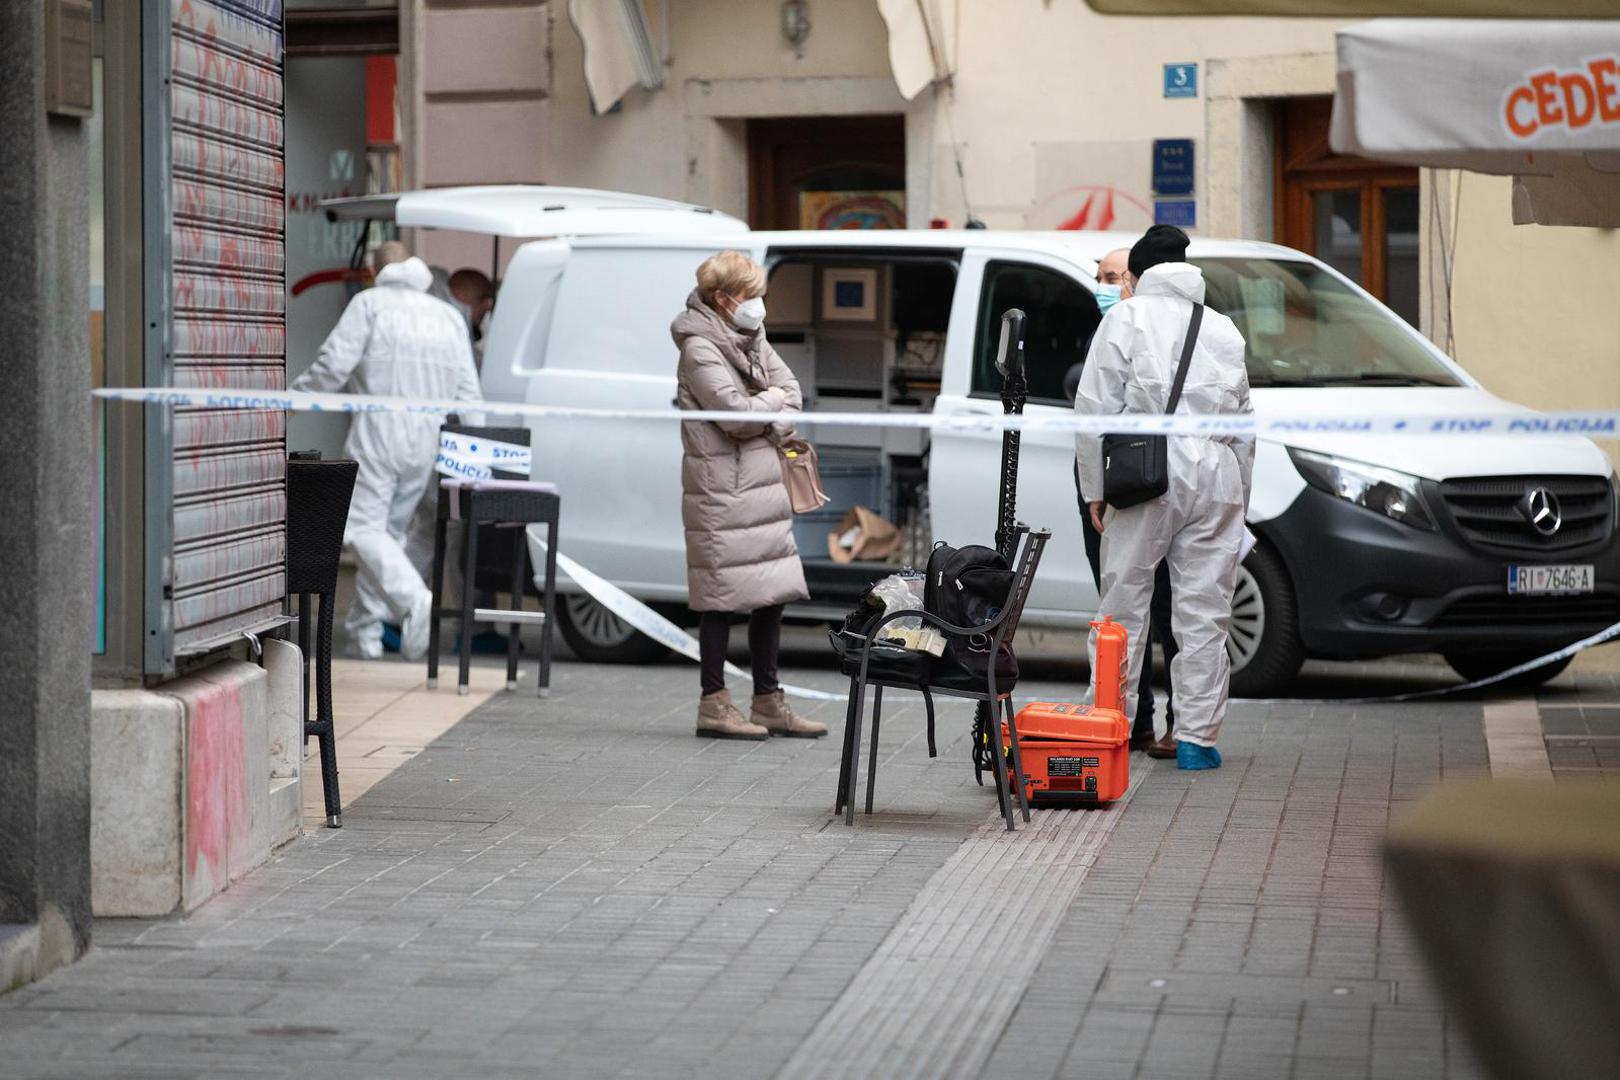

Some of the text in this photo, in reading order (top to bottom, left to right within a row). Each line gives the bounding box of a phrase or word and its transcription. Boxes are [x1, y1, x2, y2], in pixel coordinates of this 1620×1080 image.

[1174, 67, 1188, 86] 3
[1504, 57, 1620, 138] CEDE
[1430, 419, 1493, 431] STOP
[1508, 418, 1616, 432] POLICIJA
[1519, 568, 1534, 590] RI
